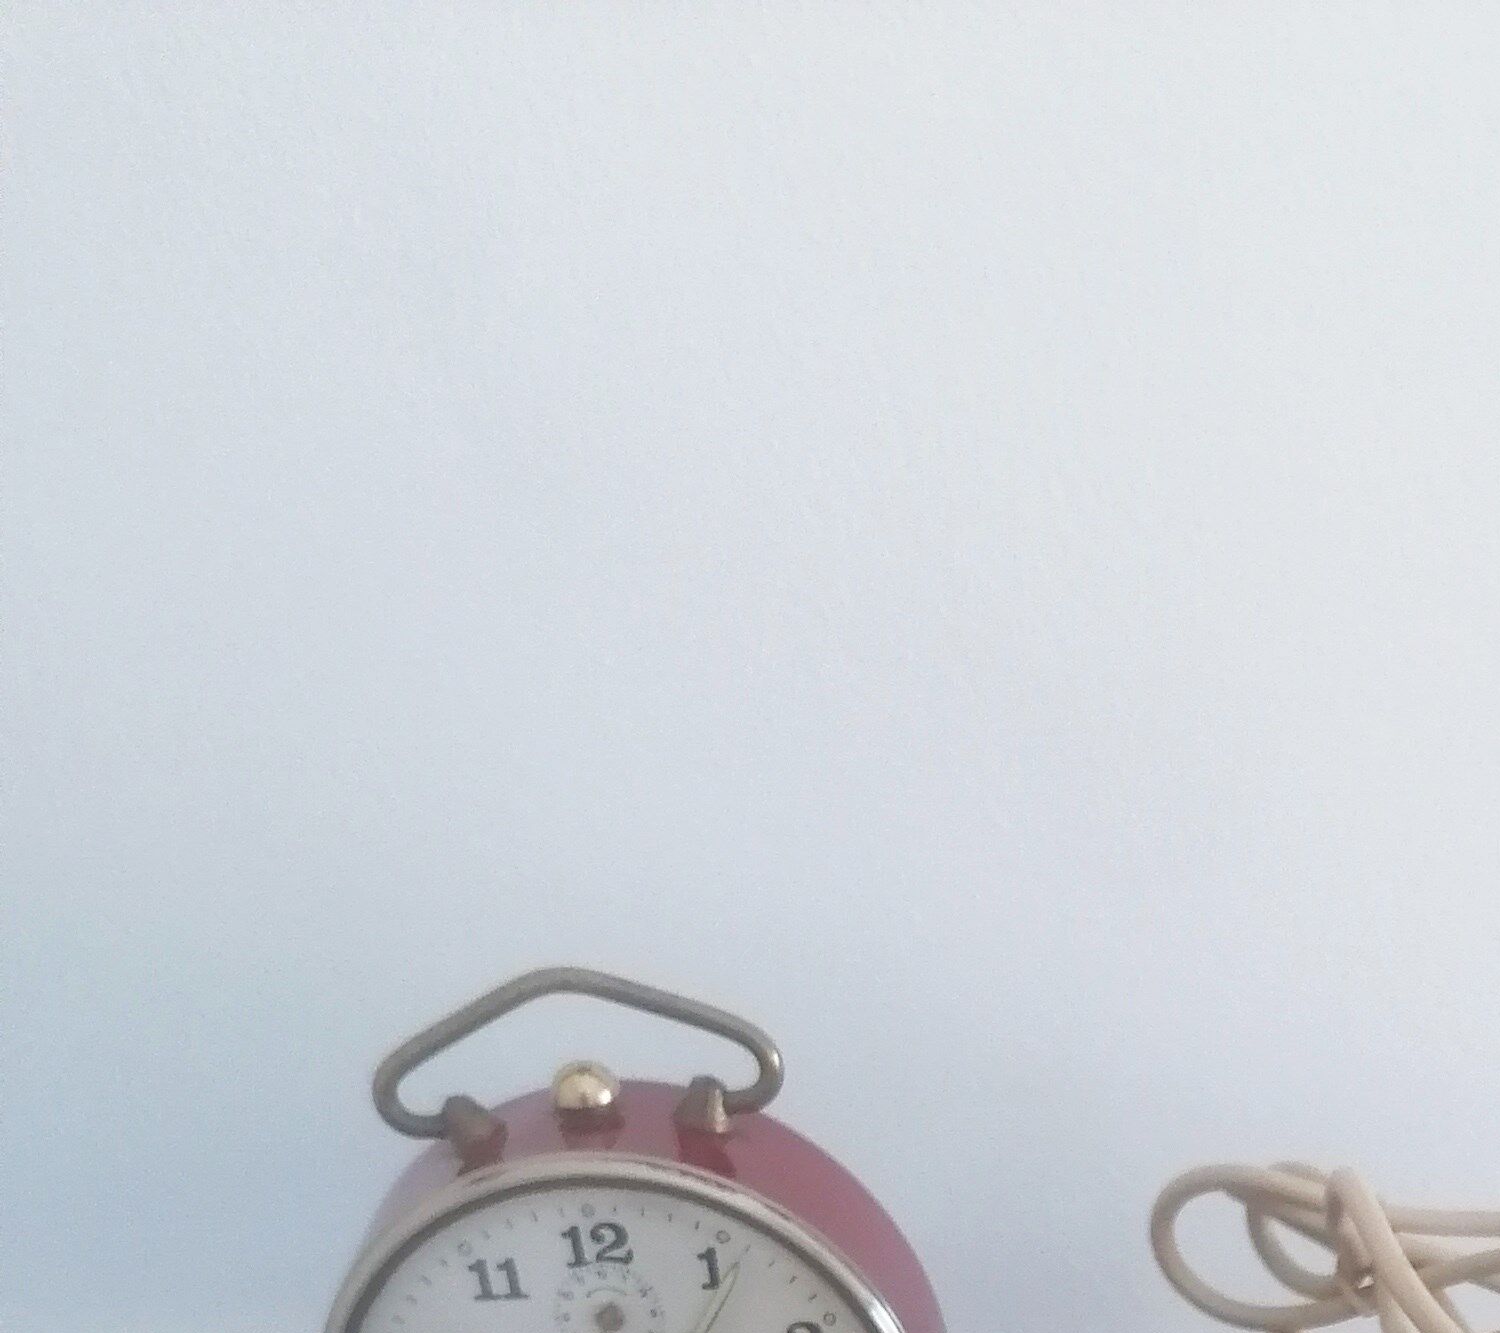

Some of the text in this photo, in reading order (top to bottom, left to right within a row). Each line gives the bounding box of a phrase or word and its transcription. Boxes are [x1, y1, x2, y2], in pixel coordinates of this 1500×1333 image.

[560, 1222, 633, 1268] 12
[467, 1258, 530, 1300] 11
[698, 1248, 721, 1290] 1
